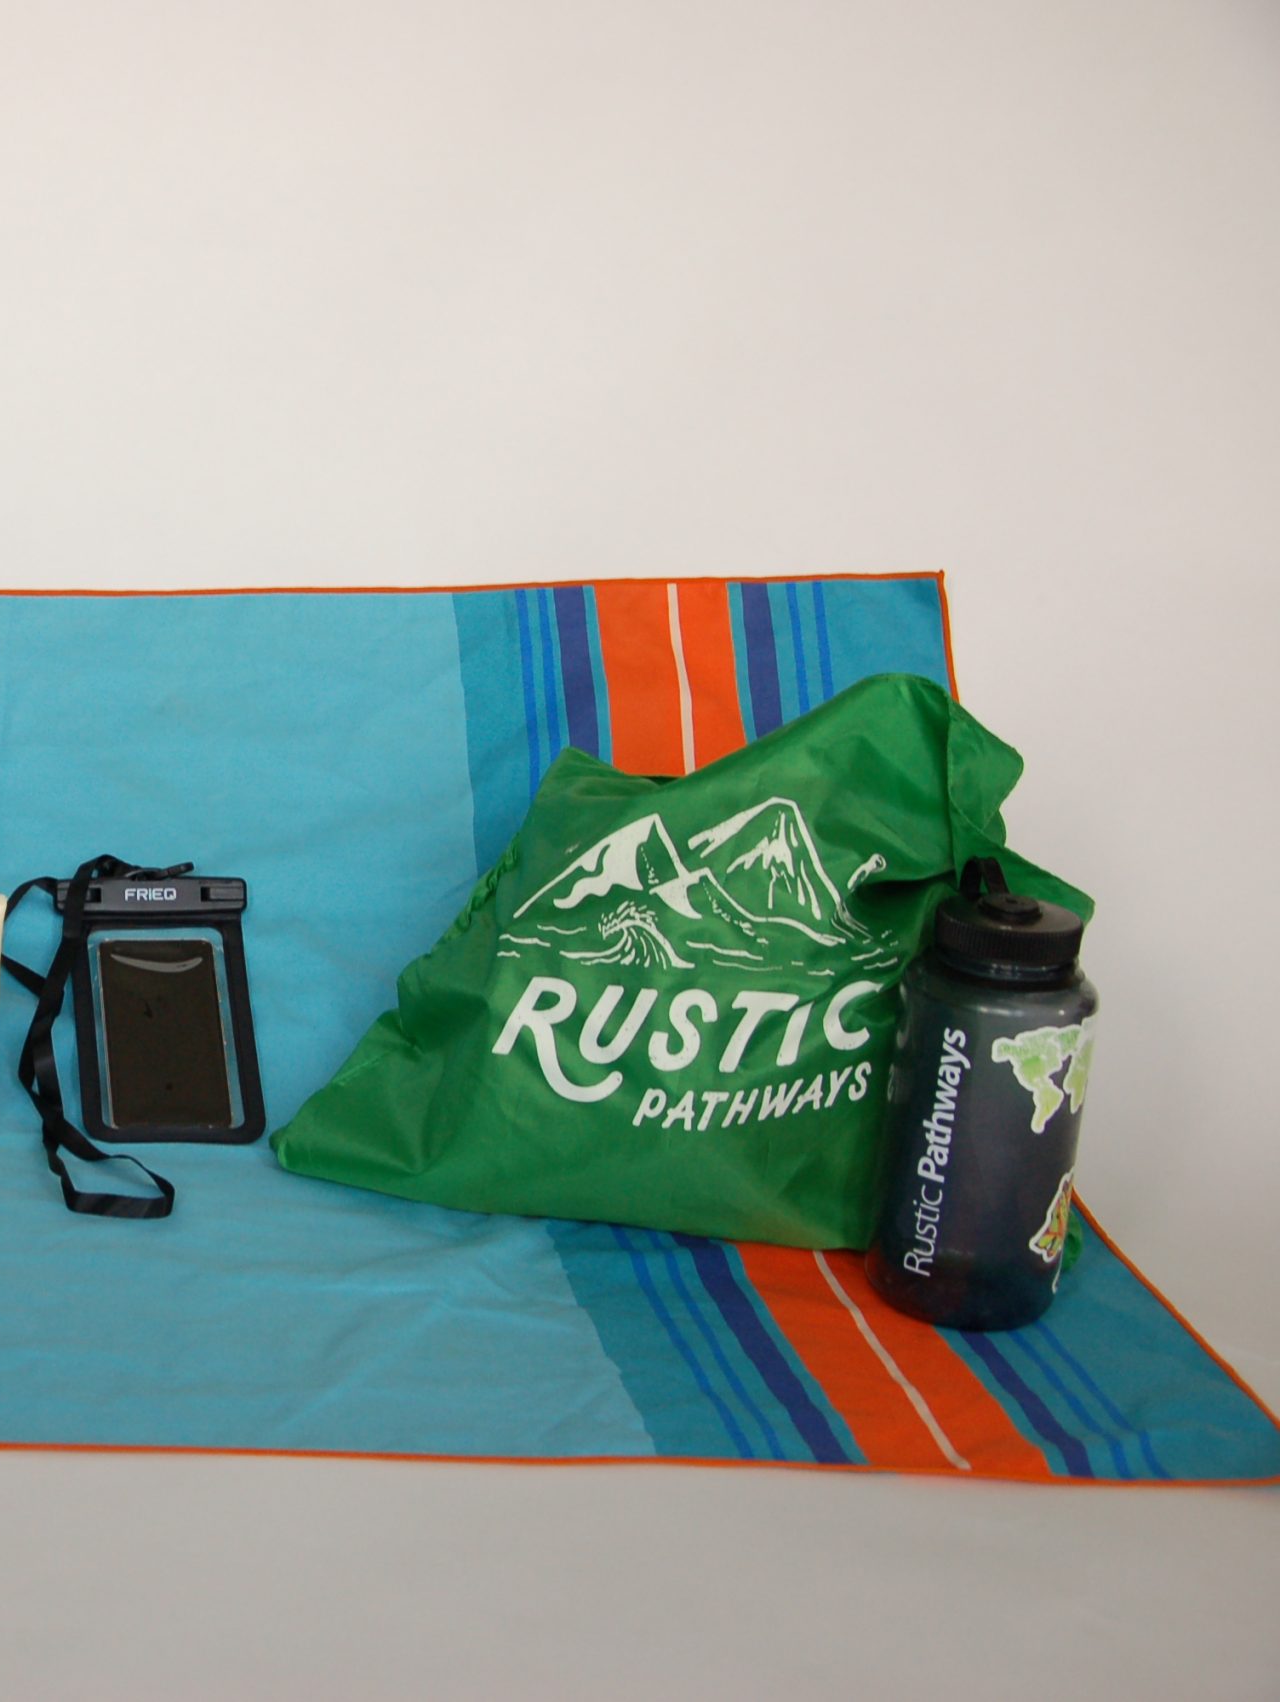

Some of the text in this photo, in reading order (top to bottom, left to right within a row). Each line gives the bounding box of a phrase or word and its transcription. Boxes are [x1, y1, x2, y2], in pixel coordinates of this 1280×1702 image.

[124, 887, 177, 902] FRIEQ
[491, 976, 884, 1104] RUSTIC
[631, 1061, 873, 1132] PATHWAYS
[903, 1027, 971, 1278] Rustic Pathways
